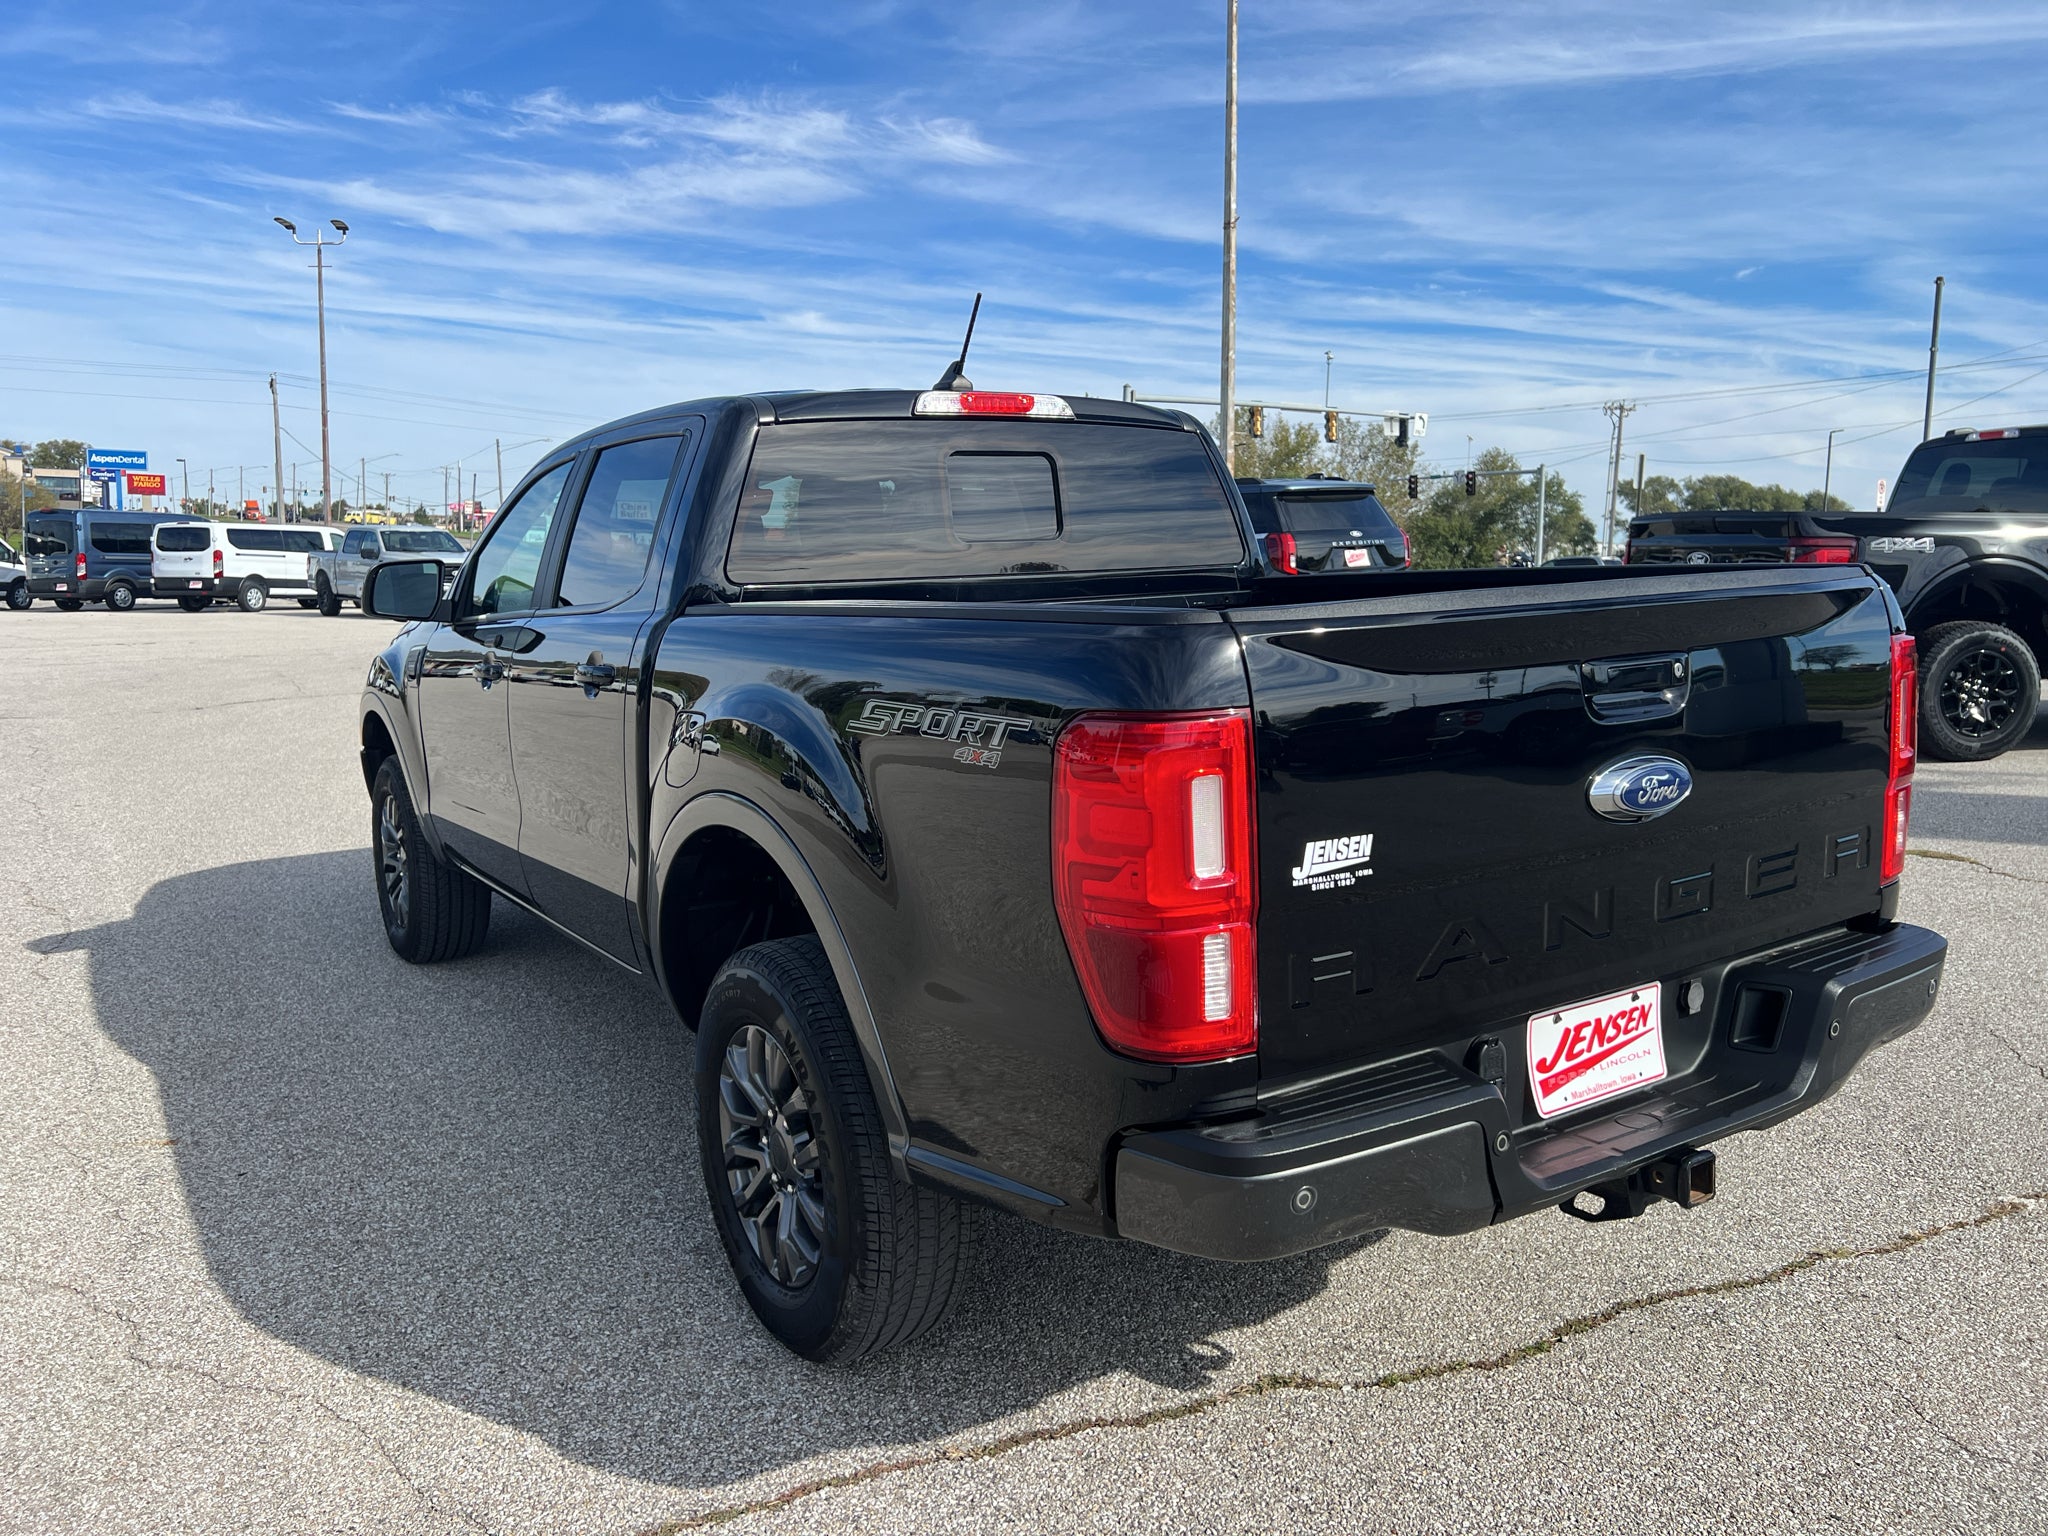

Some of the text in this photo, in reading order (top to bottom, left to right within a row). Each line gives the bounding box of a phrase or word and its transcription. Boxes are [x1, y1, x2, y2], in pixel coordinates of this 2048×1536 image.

[846, 699, 1032, 749] SPORT
[1637, 773, 1680, 804] Ford
[1292, 833, 1374, 880] JENSEN
[1292, 868, 1374, 887] MARSHALLTOWN, IOWA
[1311, 881, 1335, 891] SINCE
[1289, 826, 1871, 1008] RANGER
[1535, 1002, 1653, 1073] JENSEN
[1547, 1048, 1651, 1088] FORD LINCOLN
[1620, 1072, 1637, 1083] Iowa
